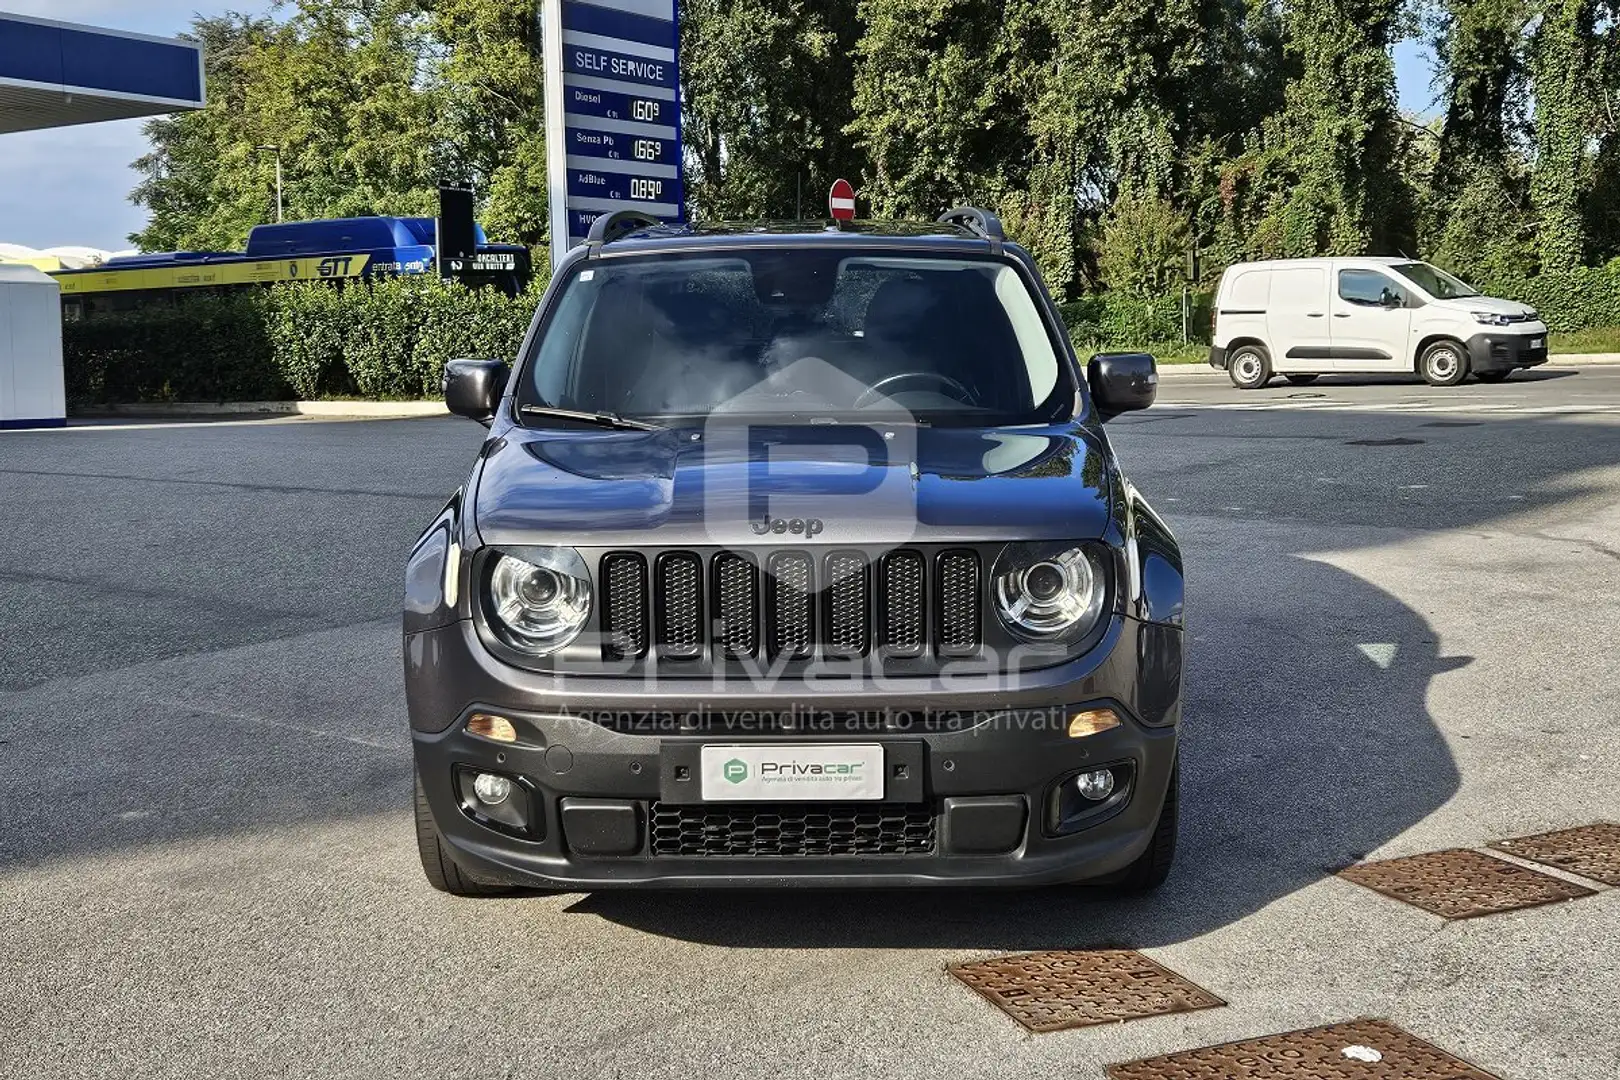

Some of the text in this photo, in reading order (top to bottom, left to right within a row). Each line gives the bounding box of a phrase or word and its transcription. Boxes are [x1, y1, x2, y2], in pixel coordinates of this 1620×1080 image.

[576, 52, 664, 81] SELF SERVICE
[575, 91, 600, 104] Diesel
[576, 132, 614, 146] Senza Pb
[578, 174, 606, 185] AdBlue
[316, 256, 352, 277] GTT
[751, 514, 824, 539] Jeep
[761, 760, 863, 775] Privacar
